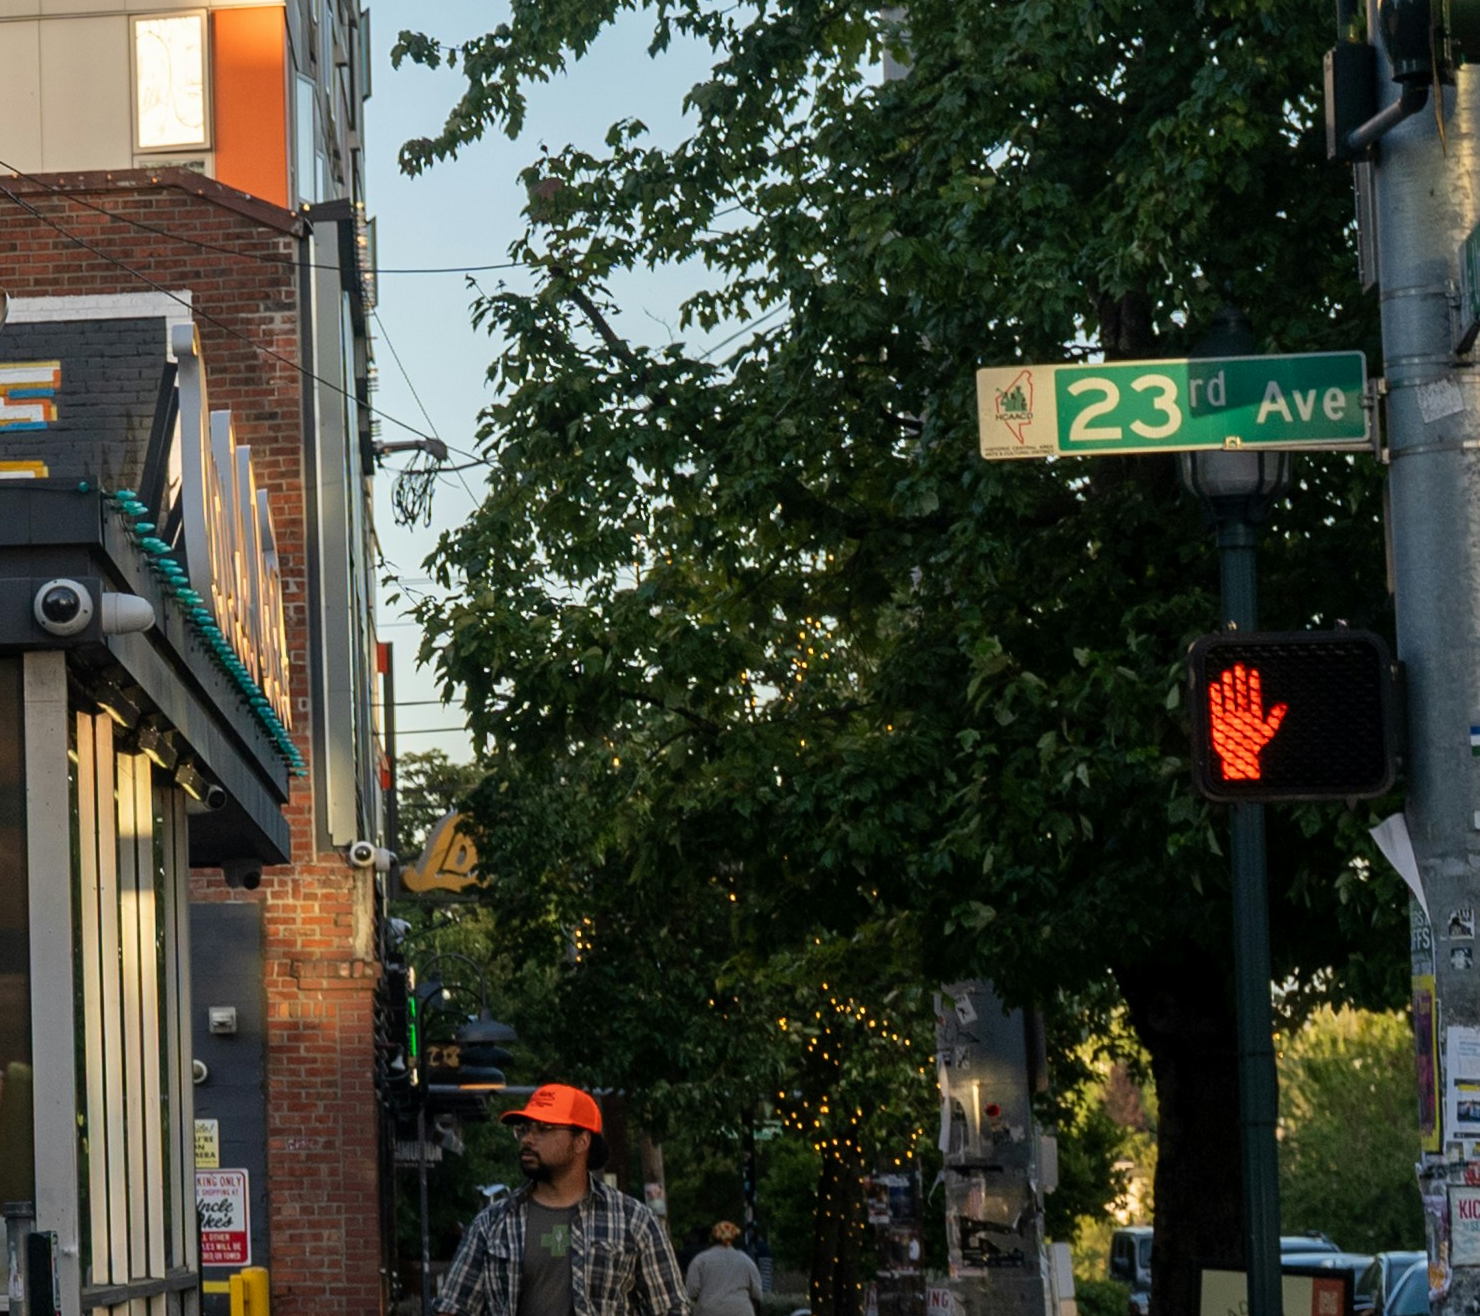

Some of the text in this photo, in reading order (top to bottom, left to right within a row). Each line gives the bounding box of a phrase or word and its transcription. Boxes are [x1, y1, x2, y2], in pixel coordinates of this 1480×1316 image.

[1257, 380, 1348, 424] Ave
[196, 1175, 242, 1187] KING ONLY
[201, 1188, 230, 1197] SHOPPING
[209, 1233, 231, 1242] OTHER
[215, 1242, 231, 1251] WILL
